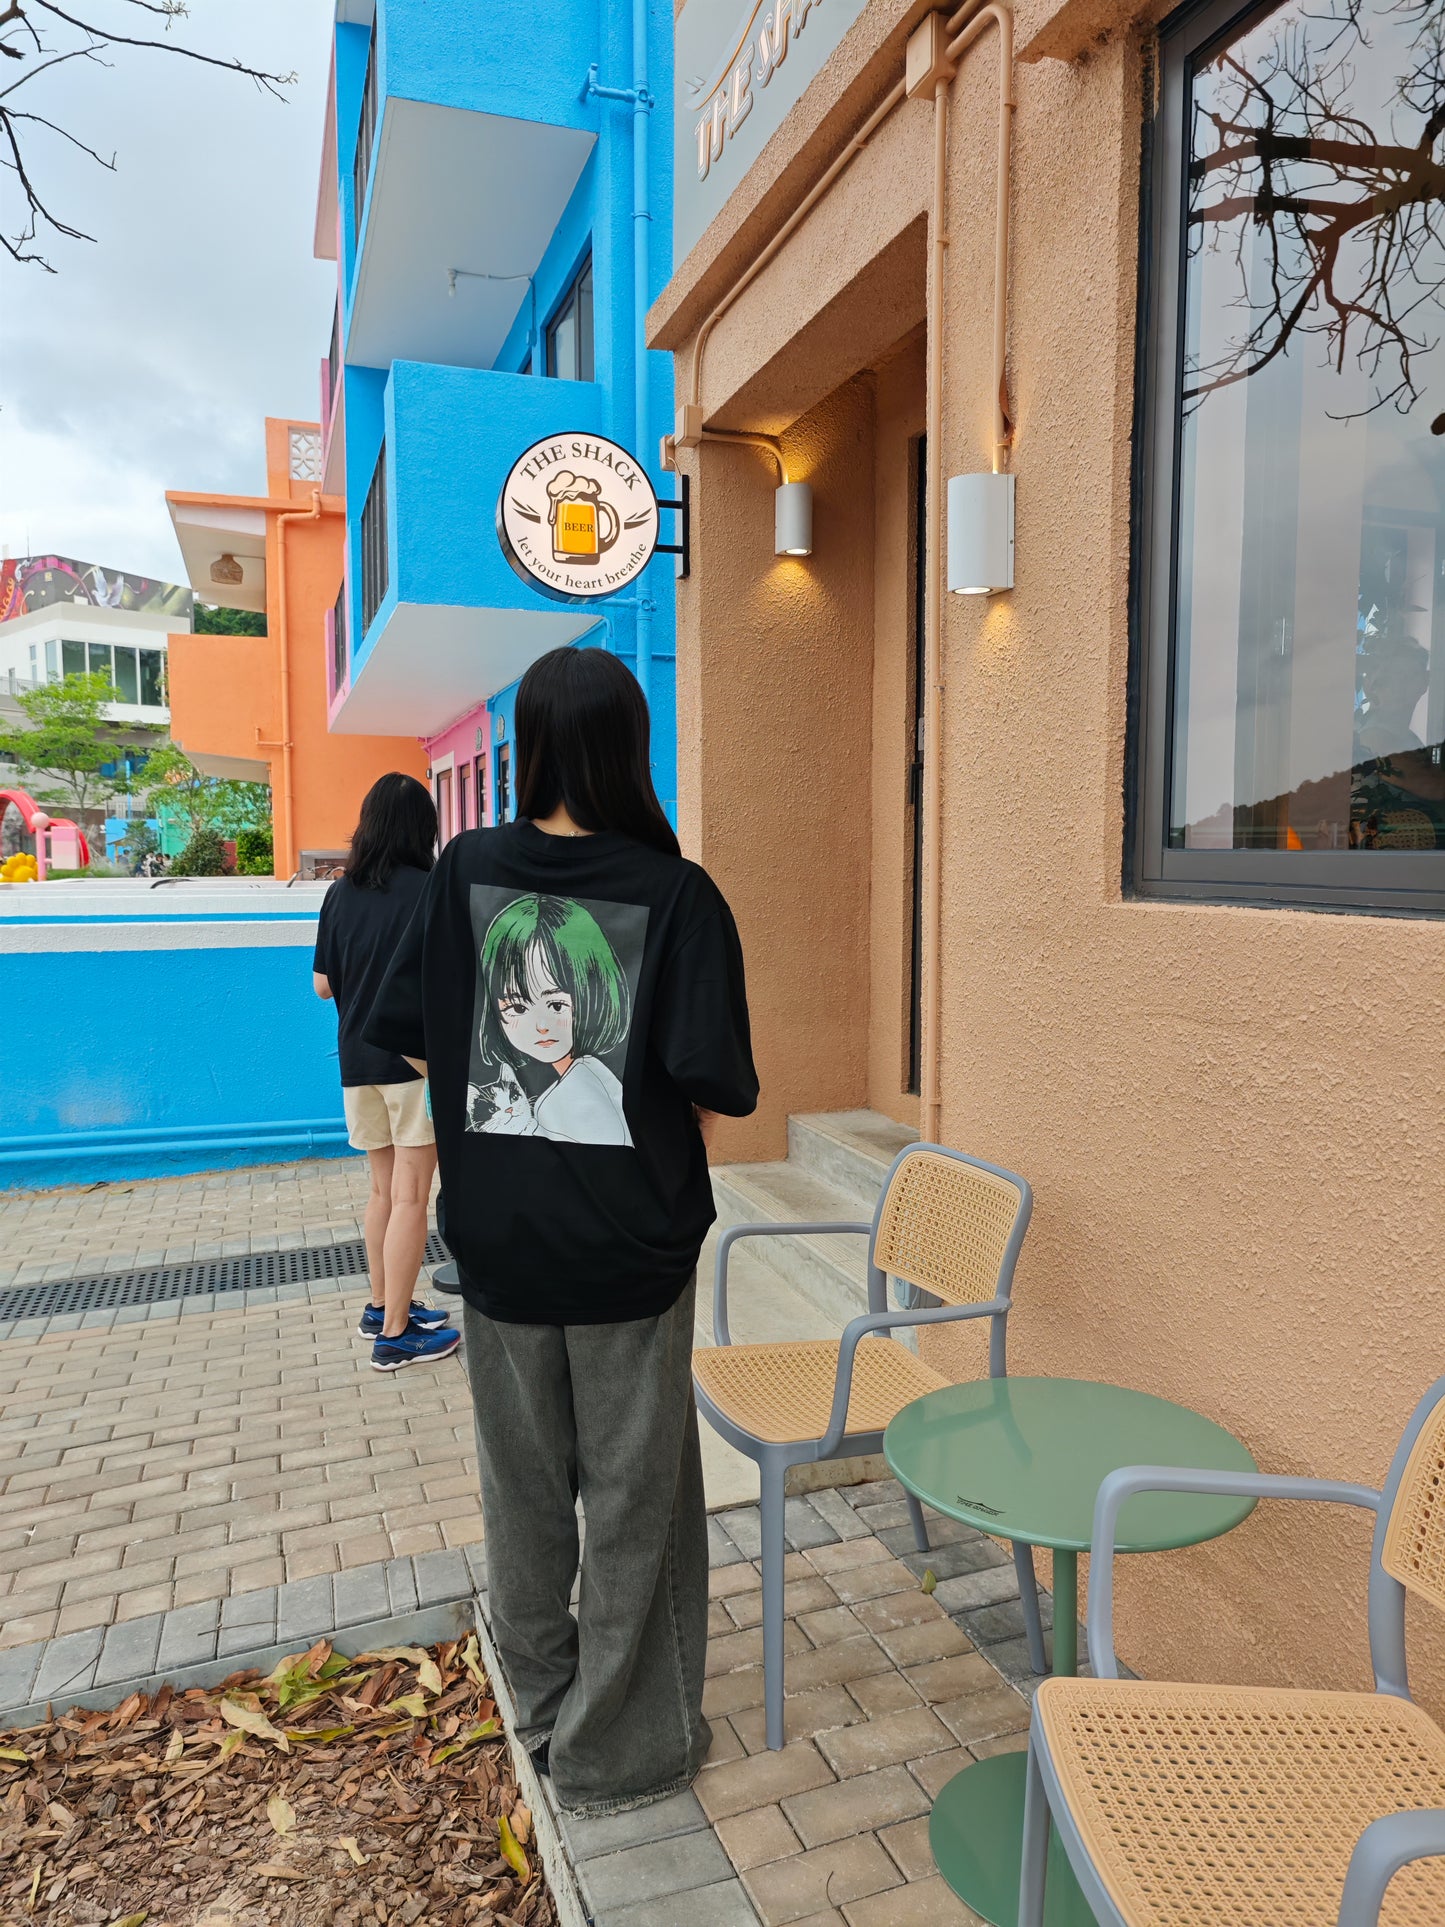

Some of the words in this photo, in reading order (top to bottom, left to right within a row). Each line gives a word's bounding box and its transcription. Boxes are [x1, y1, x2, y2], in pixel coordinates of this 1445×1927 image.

[695, 41, 755, 182] THE
[520, 444, 566, 481] THE
[571, 442, 642, 492] SHACK
[564, 522, 594, 533] BEER
[517, 536, 533, 557] let
[528, 557, 562, 583] your
[565, 574, 603, 589] heart
[605, 543, 647, 584] breathe
